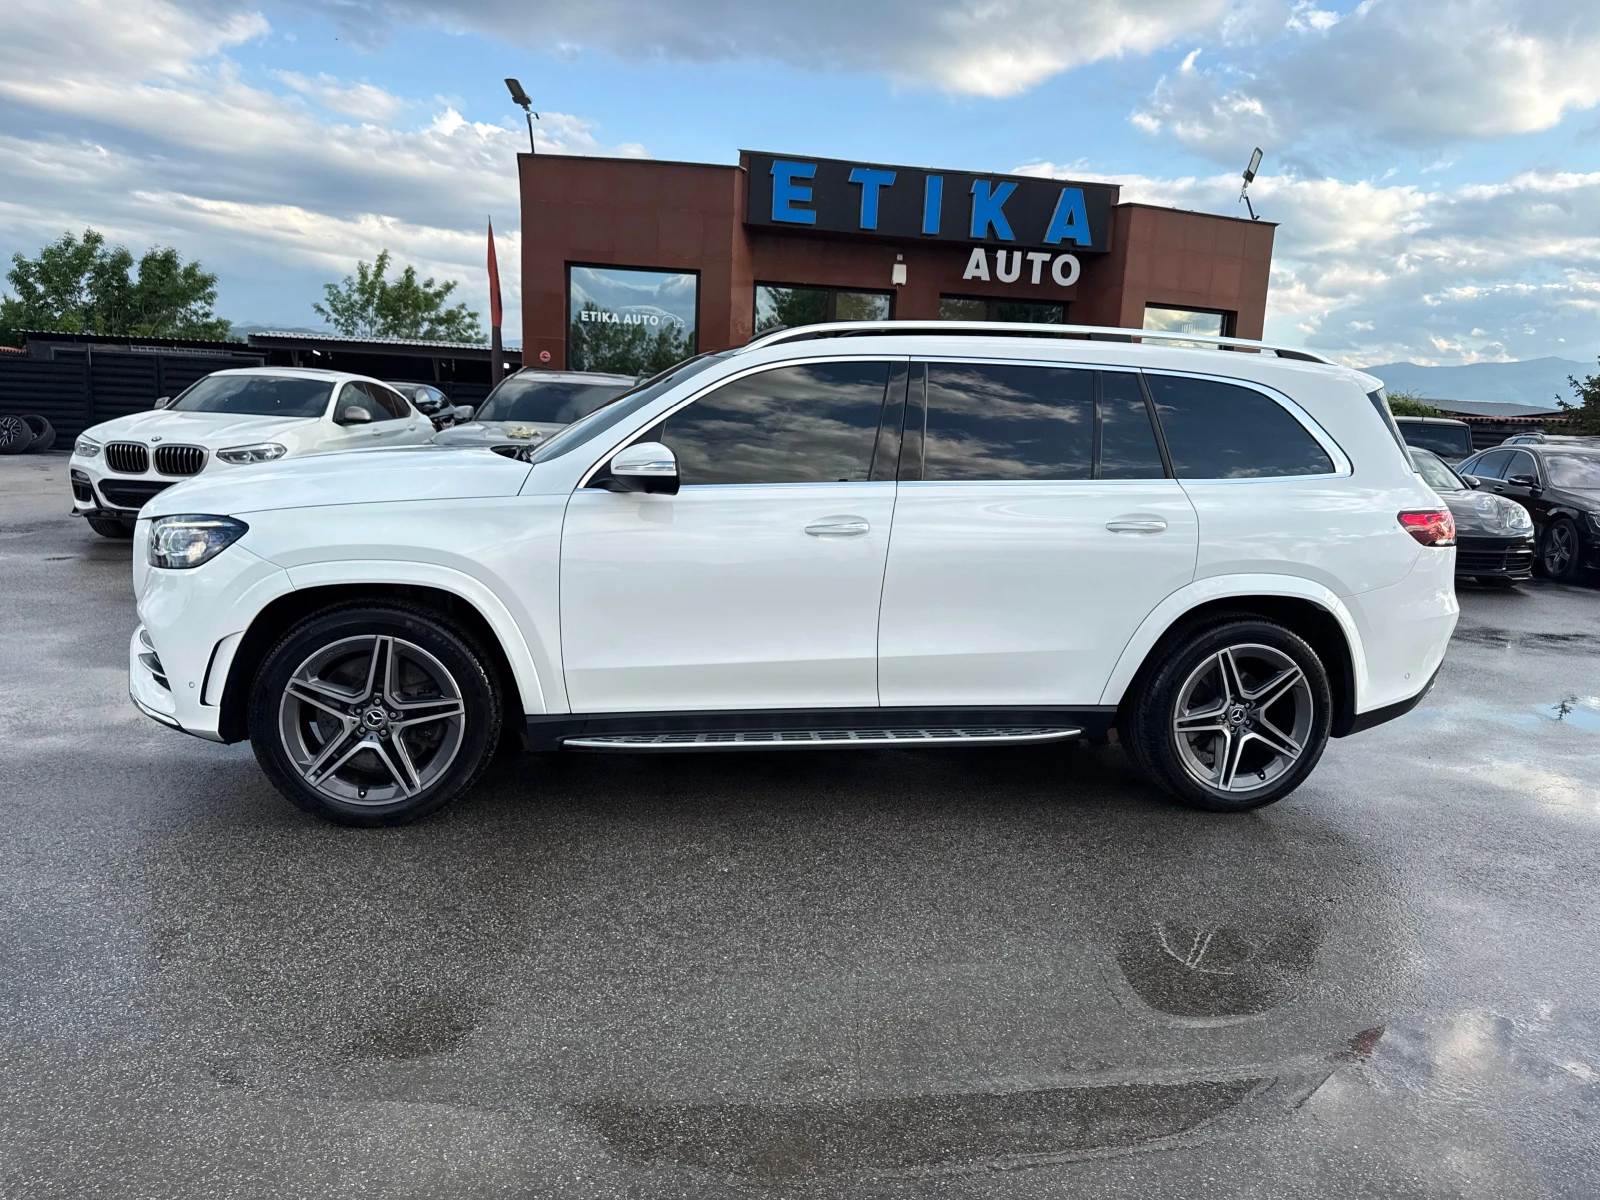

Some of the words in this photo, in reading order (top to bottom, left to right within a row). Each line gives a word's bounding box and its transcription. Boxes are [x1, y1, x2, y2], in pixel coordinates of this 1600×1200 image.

[770, 160, 1092, 247] ETIKA
[963, 247, 1081, 287] AUTO
[581, 311, 619, 323] ETIKA
[623, 314, 659, 325] AUTO
